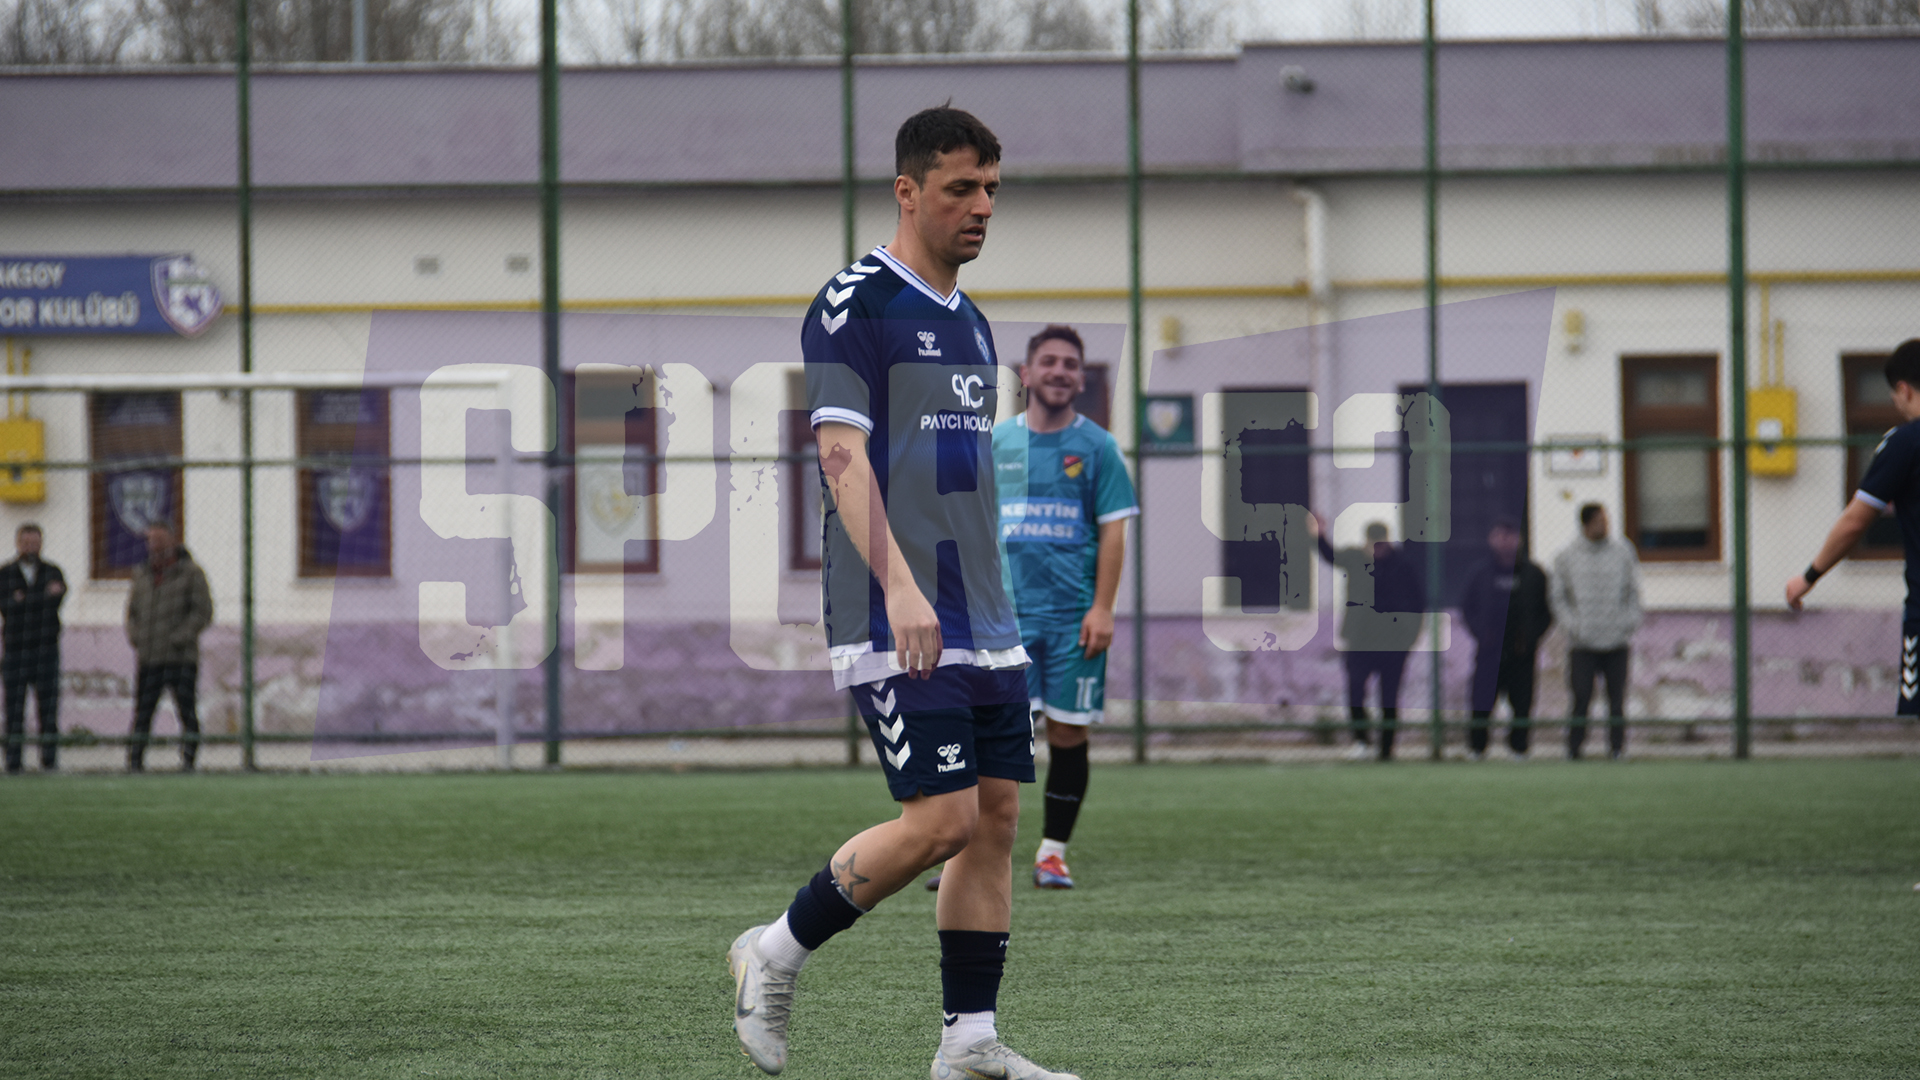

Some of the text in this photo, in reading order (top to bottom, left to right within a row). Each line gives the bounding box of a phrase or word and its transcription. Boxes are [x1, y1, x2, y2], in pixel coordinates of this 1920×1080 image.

[39, 291, 140, 327] KULÜBÜ
[920, 414, 962, 430] PAYCI
[1001, 502, 1079, 519] KENTİN
